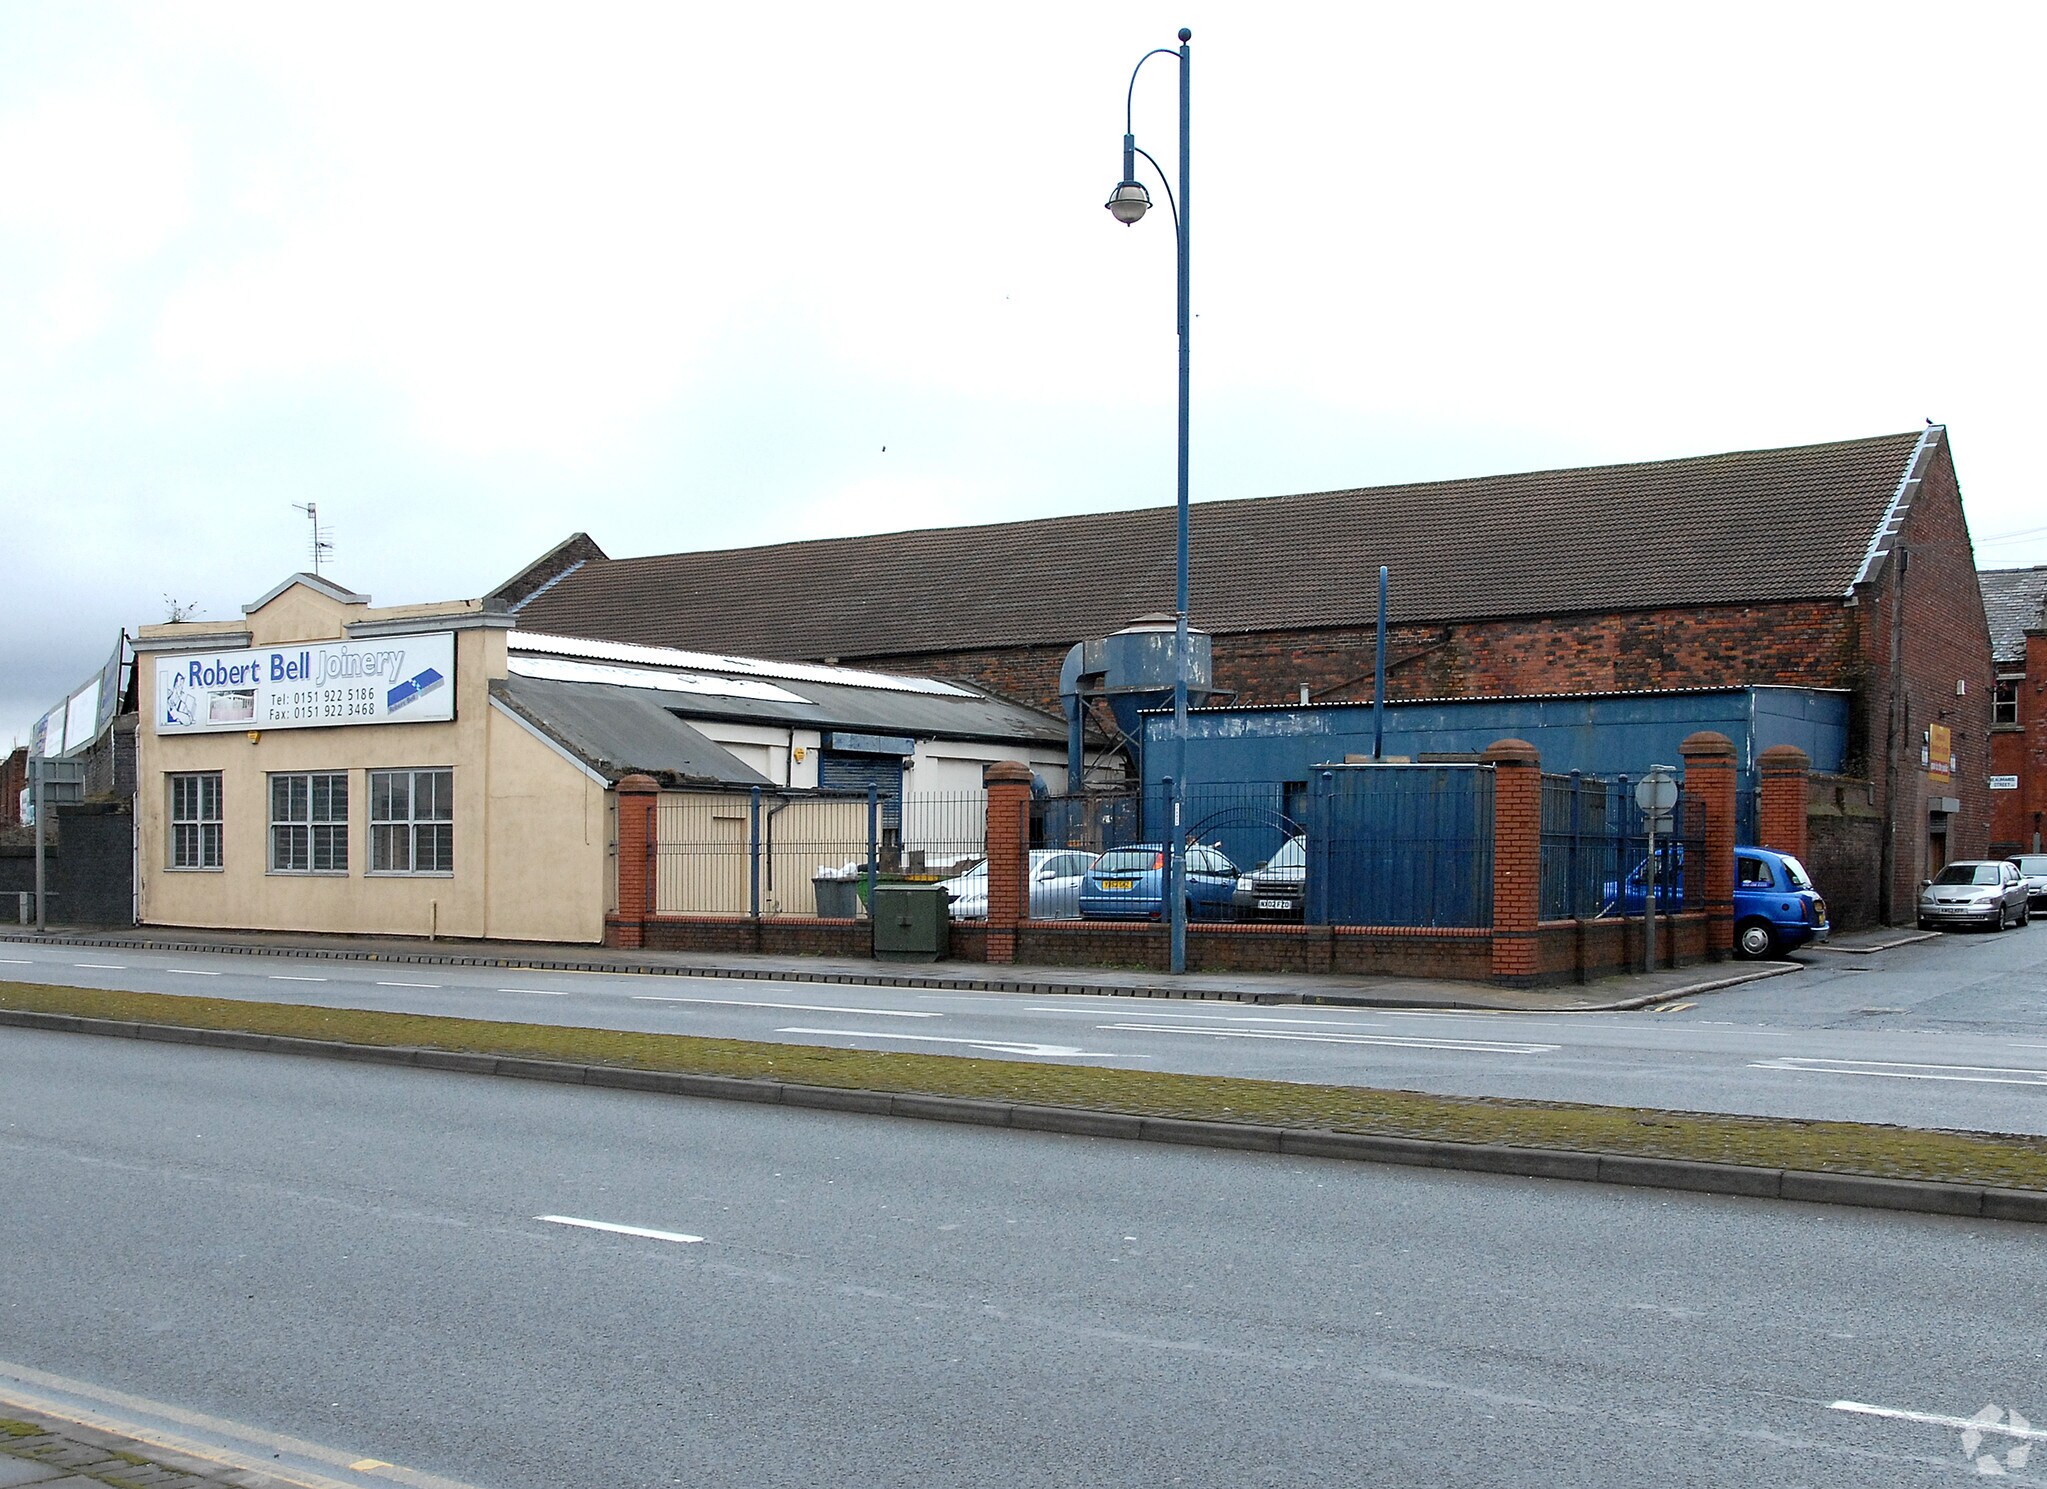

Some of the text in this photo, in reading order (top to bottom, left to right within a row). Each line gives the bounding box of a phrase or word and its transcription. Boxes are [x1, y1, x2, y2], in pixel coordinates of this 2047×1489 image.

[189, 645, 405, 687] Robert Bell Joinery
[271, 687, 375, 706] Tel: 0151 922 5186
[269, 702, 375, 720] Fax: 0151 922 3468
